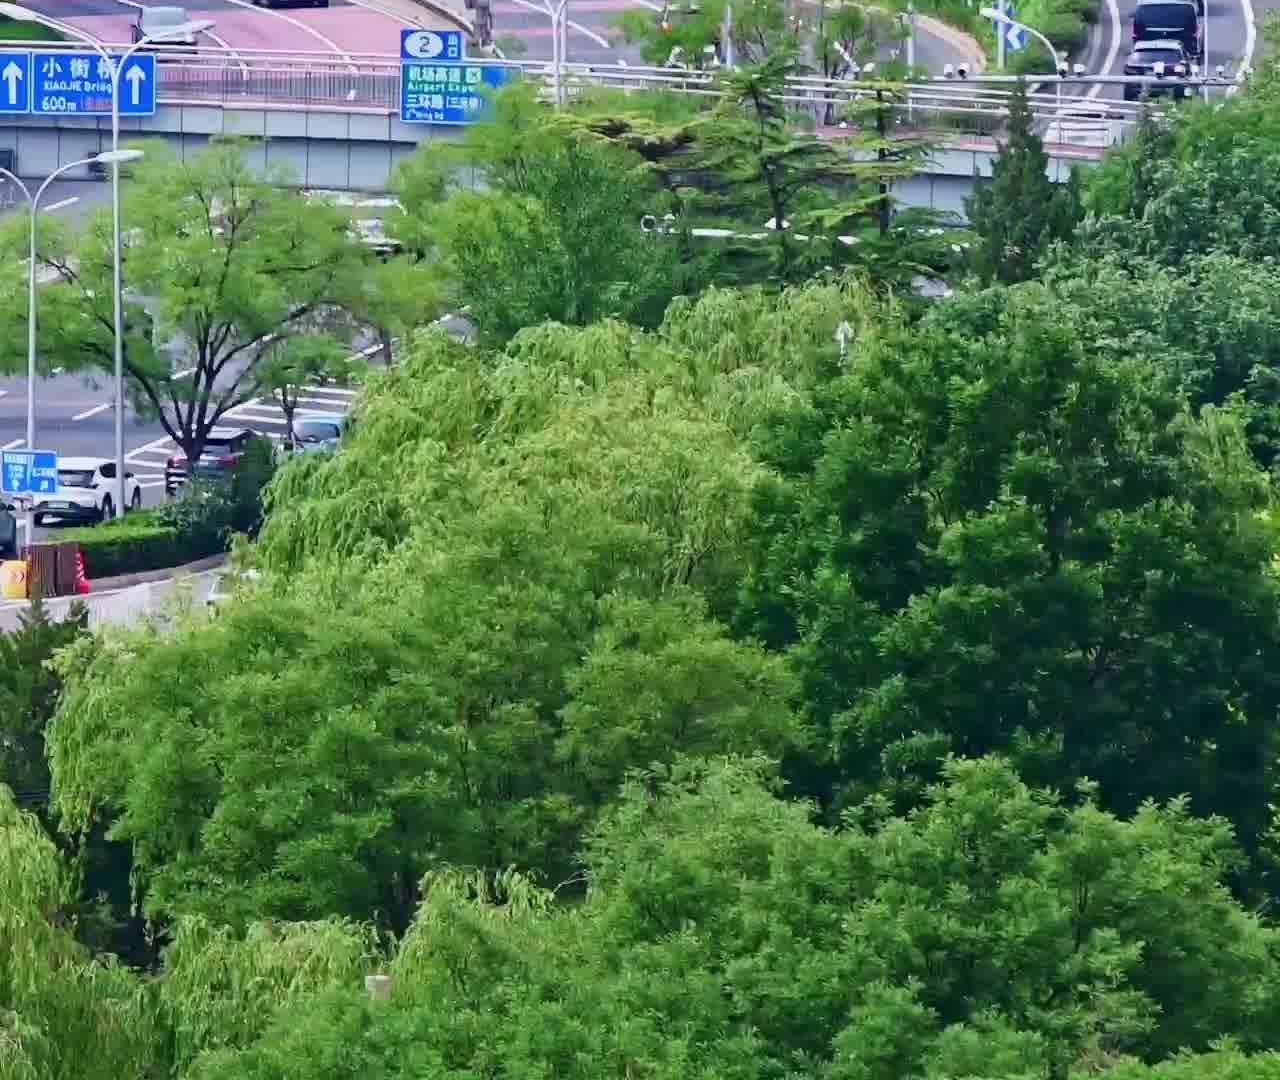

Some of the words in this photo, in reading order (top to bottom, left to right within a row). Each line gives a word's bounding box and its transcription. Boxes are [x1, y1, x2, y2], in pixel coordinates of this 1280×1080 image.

[419, 35, 430, 53] 2
[408, 66, 461, 82] 机场高速
[43, 80, 82, 92] XIAOJIE
[84, 82, 113, 95] Bridg
